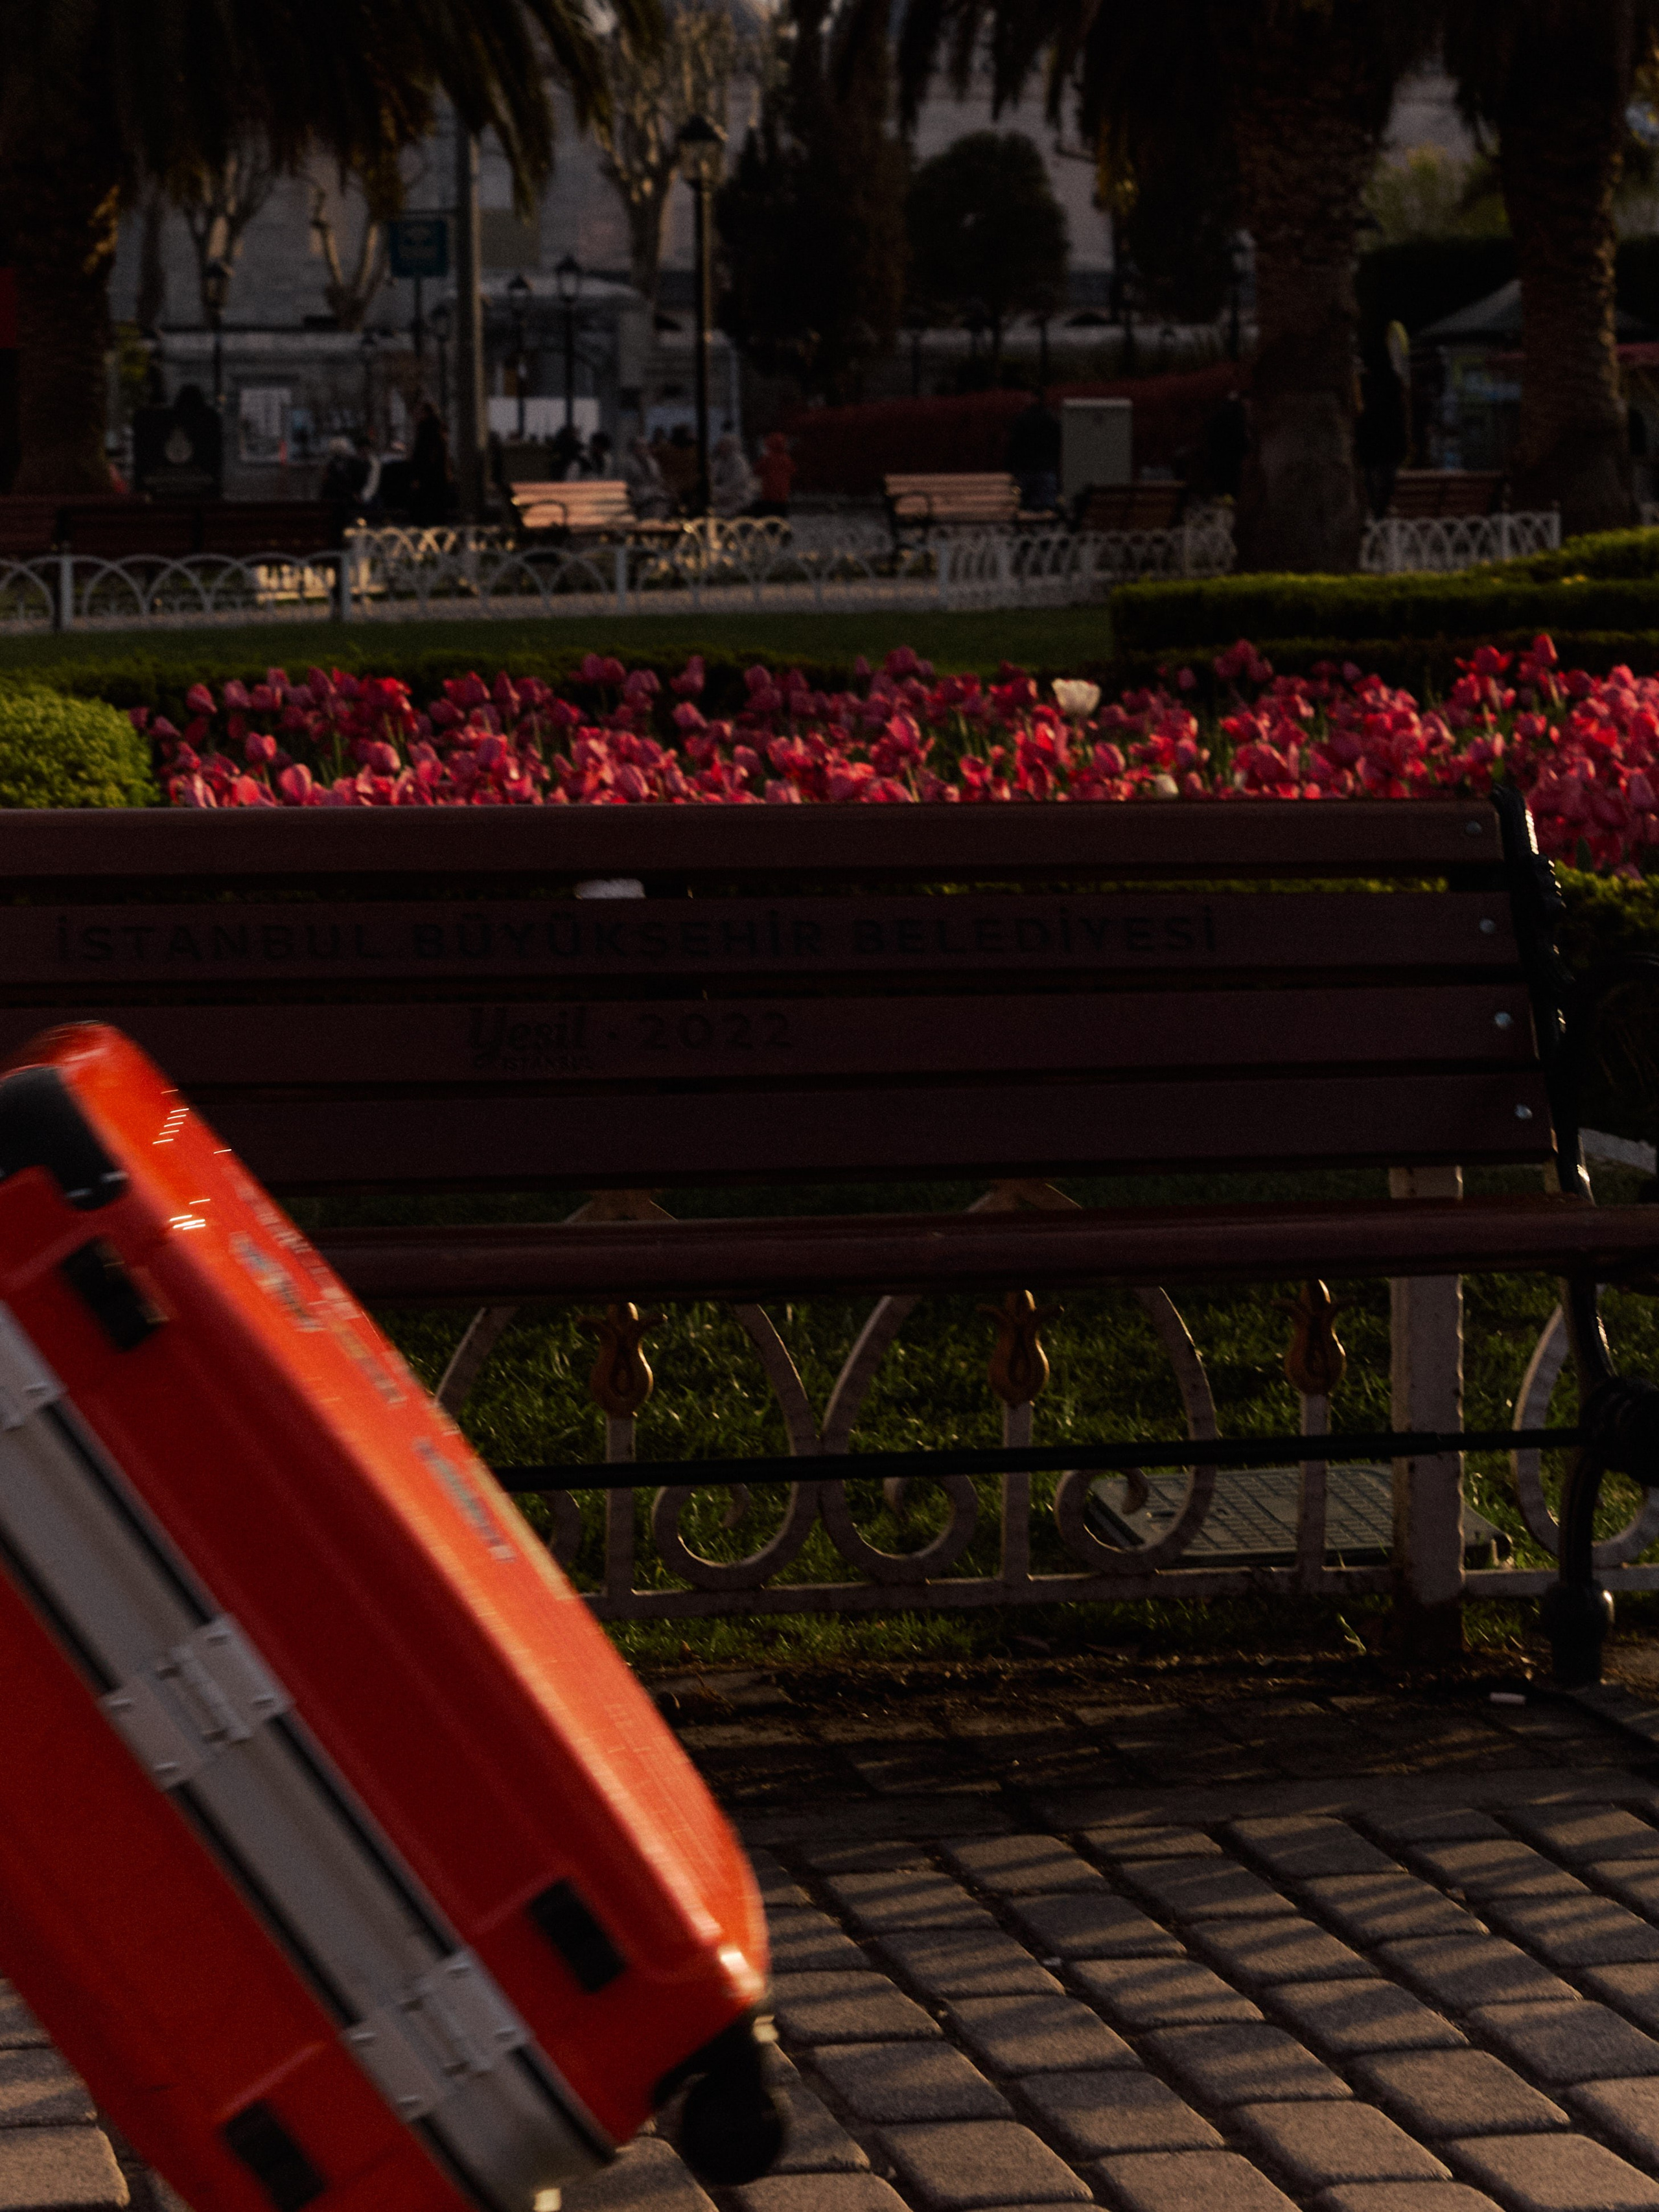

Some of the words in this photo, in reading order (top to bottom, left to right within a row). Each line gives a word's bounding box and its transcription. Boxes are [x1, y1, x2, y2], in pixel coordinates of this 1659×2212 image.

[58, 915, 382, 961] İSTANBUL
[852, 905, 1216, 955] BELEDİYESİ
[637, 1012, 793, 1051] 2022
